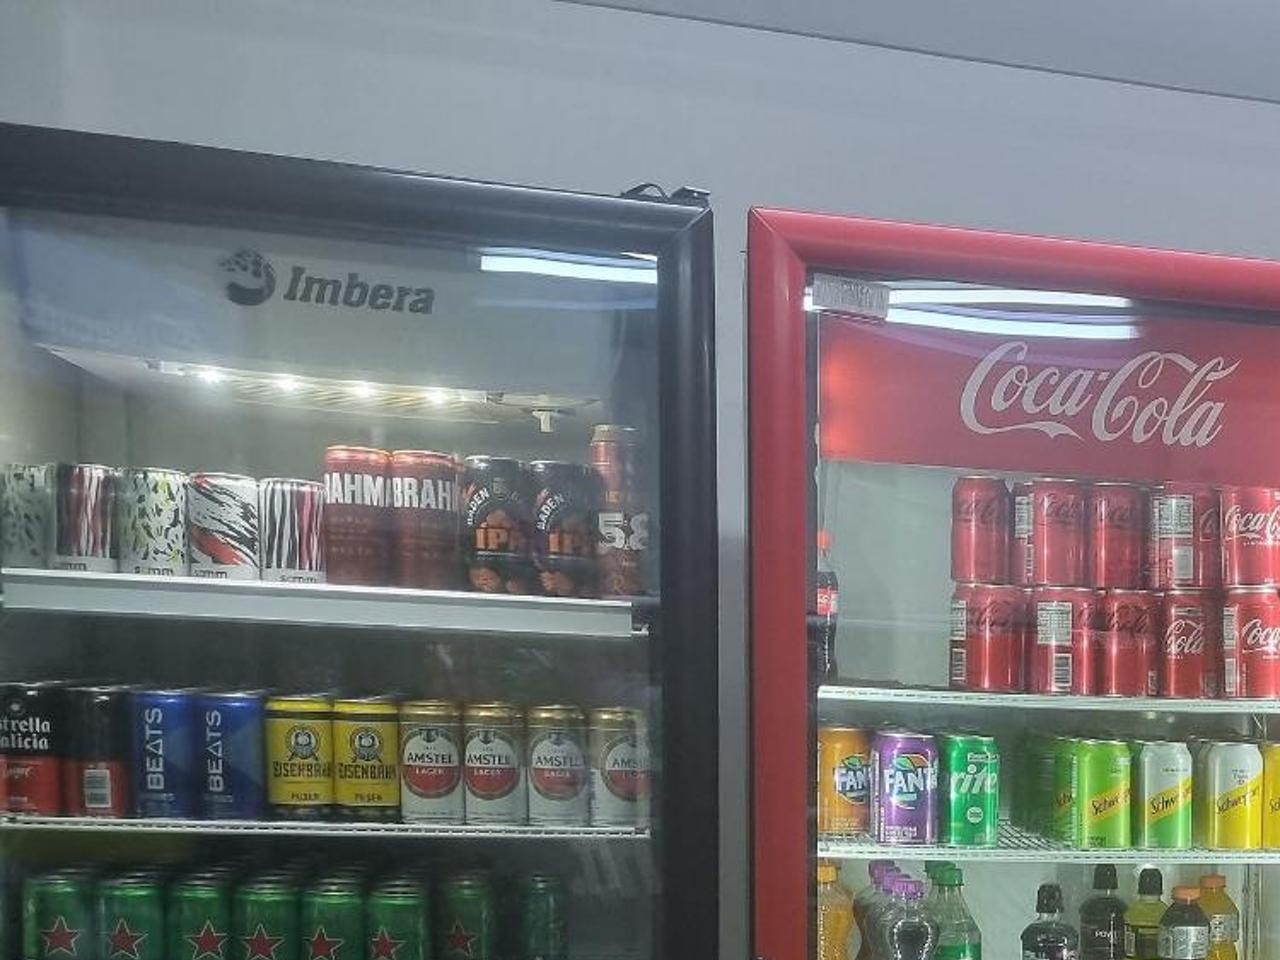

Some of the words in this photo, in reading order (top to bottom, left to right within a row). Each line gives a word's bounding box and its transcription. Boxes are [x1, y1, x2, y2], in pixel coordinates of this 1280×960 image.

[283, 266, 437, 315] Imbera
[960, 341, 1241, 447] Coca-Cola
[0, 733, 49, 750] alicia
[145, 706, 165, 790] BEATS
[207, 709, 225, 792] BEATS
